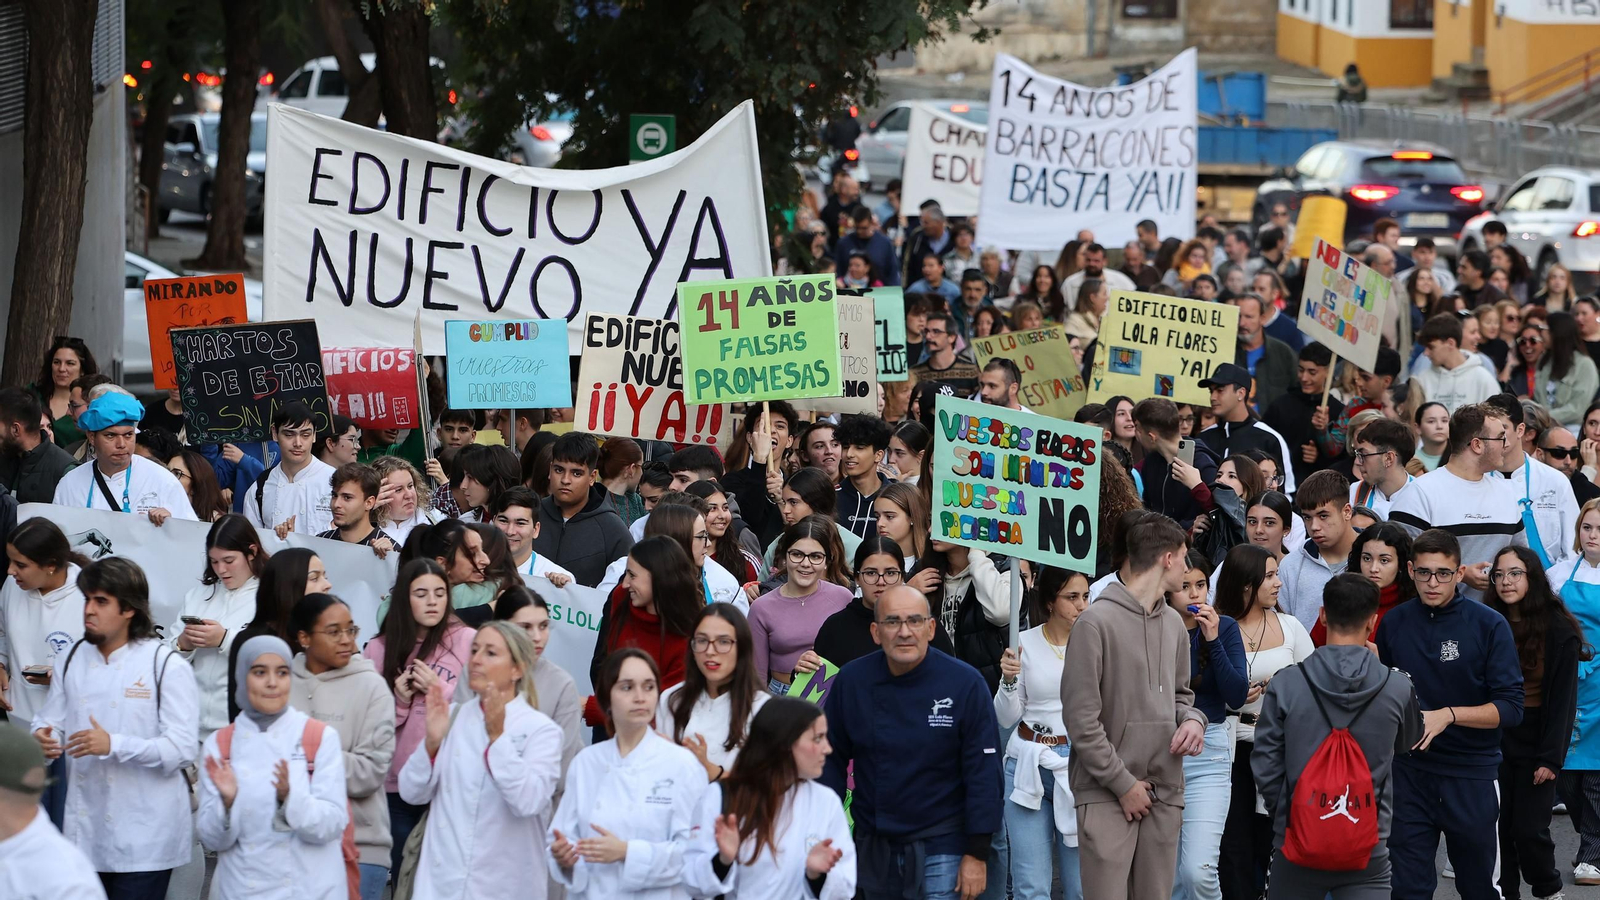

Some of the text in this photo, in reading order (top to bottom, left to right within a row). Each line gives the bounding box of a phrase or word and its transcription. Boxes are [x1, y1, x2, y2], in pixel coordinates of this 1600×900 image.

[999, 69, 1037, 113] 14
[1145, 71, 1181, 113] DE
[929, 117, 987, 148] CHA
[995, 118, 1195, 169] BARRACONES
[308, 147, 603, 246] EDIFICIO
[1009, 164, 1110, 212] BASTA
[620, 188, 734, 320] YA
[1316, 239, 1341, 270] NO
[1344, 256, 1360, 281] ES
[147, 279, 238, 301] MIRANDO
[306, 227, 582, 320] NUEVO
[697, 277, 834, 332] 14 AÑOS
[838, 302, 862, 322] AMOS
[1117, 296, 1225, 328] EDIFICIO EN EL
[1321, 287, 1338, 311] ES
[468, 321, 539, 343] CUMPLID
[767, 310, 796, 329] DE
[186, 328, 298, 363] HARTOS
[719, 330, 808, 361] FALSAS
[975, 328, 1060, 358] NO LO QUEREMOS
[1122, 321, 1218, 354] LOLA FLORES
[202, 362, 323, 399] DE ESTAR
[455, 354, 549, 377] vuestras
[694, 358, 830, 400] PROMESAS
[468, 380, 537, 402] PROMESAS
[208, 405, 263, 431] SIN
[938, 408, 1097, 466] VUESTROS PLAZOS
[951, 446, 1085, 491] SON INFINITOS
[942, 480, 1027, 515] NUESTRA
[939, 510, 1023, 545] PACIENCIA
[1038, 496, 1092, 560] NO
